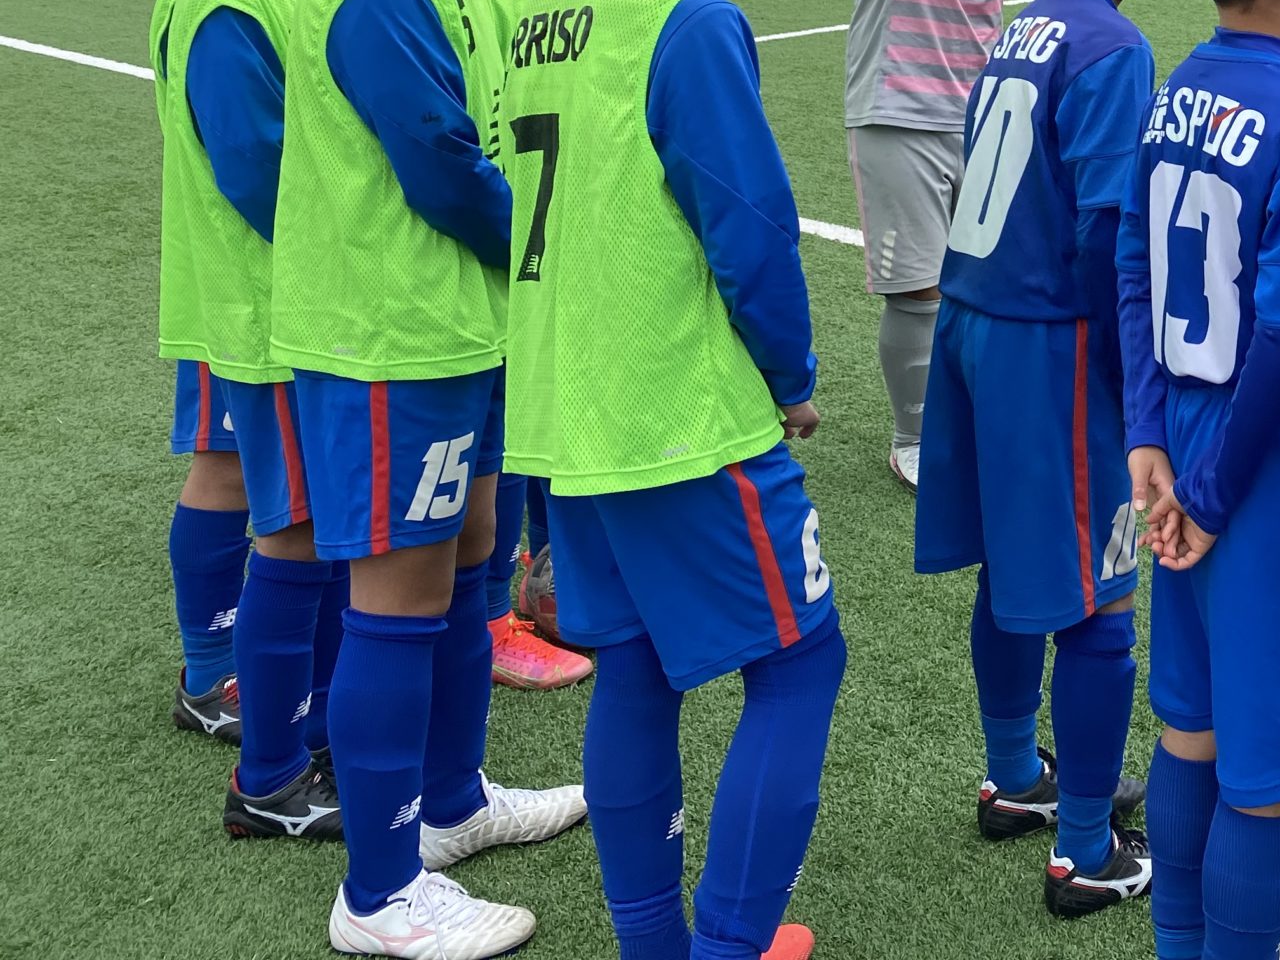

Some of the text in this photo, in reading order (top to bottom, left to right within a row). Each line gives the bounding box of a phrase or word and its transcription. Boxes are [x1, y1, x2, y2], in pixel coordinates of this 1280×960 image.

[511, 5, 594, 68] RRISO
[509, 112, 560, 282] 7
[947, 75, 1039, 259] 10
[1149, 160, 1243, 385] 13
[404, 430, 475, 522] 15
